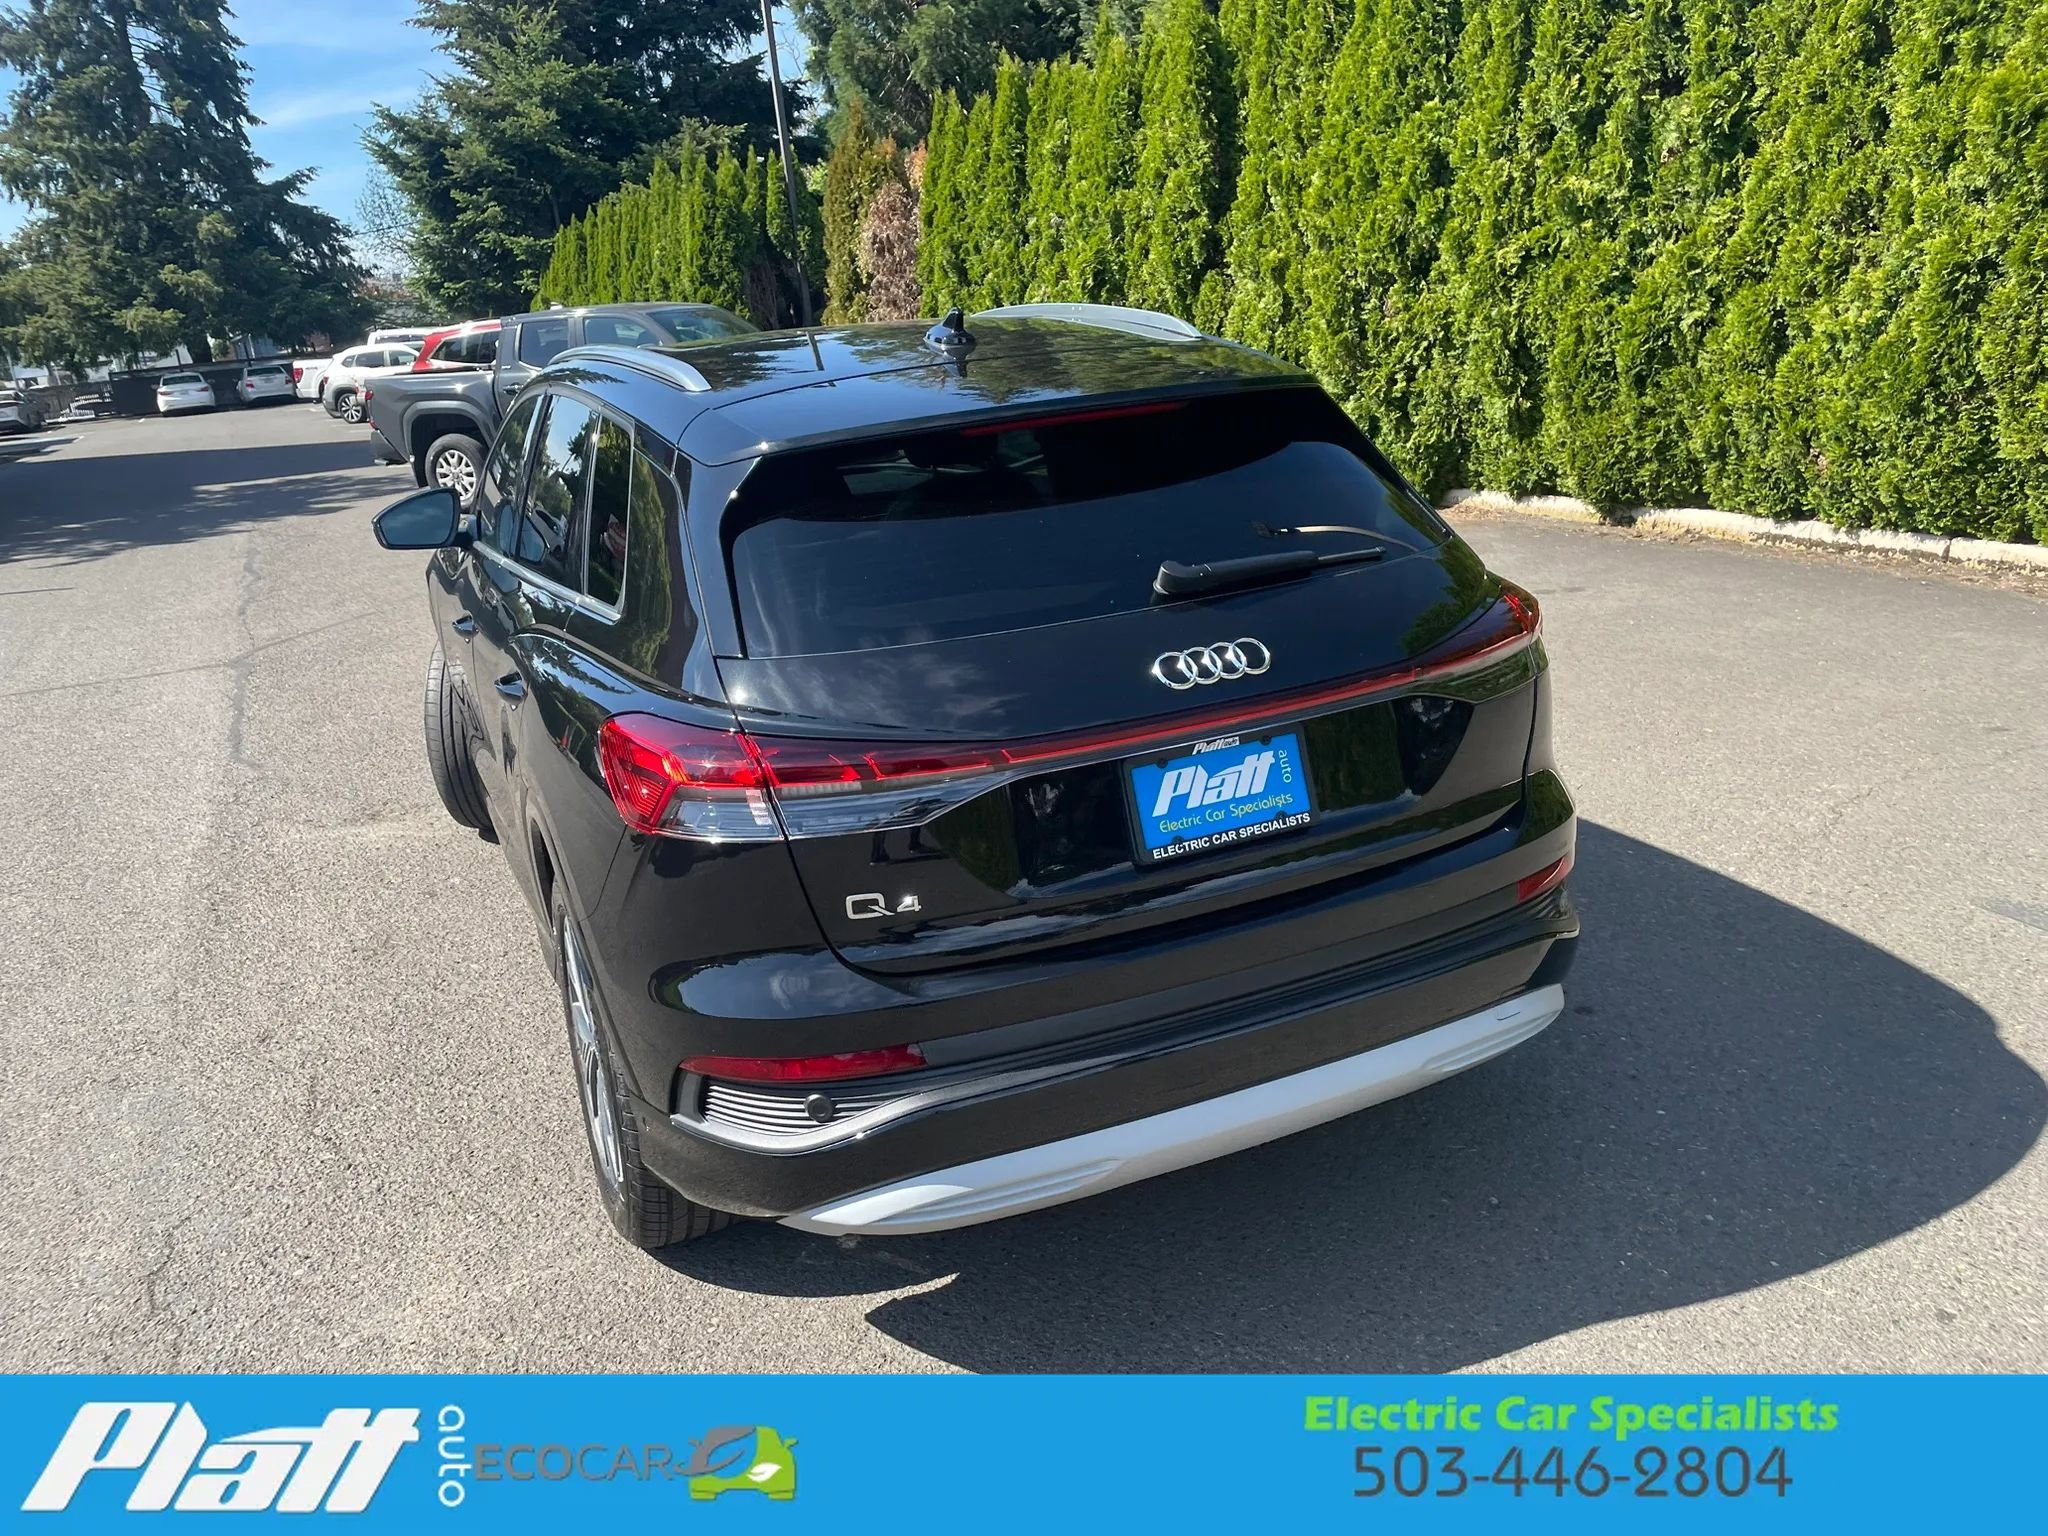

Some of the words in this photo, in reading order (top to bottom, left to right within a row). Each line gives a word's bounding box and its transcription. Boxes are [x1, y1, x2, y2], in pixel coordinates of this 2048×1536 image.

[1151, 751, 1275, 817] Platt
[1278, 750, 1292, 783] auto
[1159, 815, 1202, 833] Electric
[1205, 807, 1225, 822] Car
[1230, 793, 1293, 818] Specialists
[1152, 838, 1210, 859] ELECTRIC
[1212, 832, 1237, 845] CAR
[1239, 812, 1311, 839] SPECIALISTS
